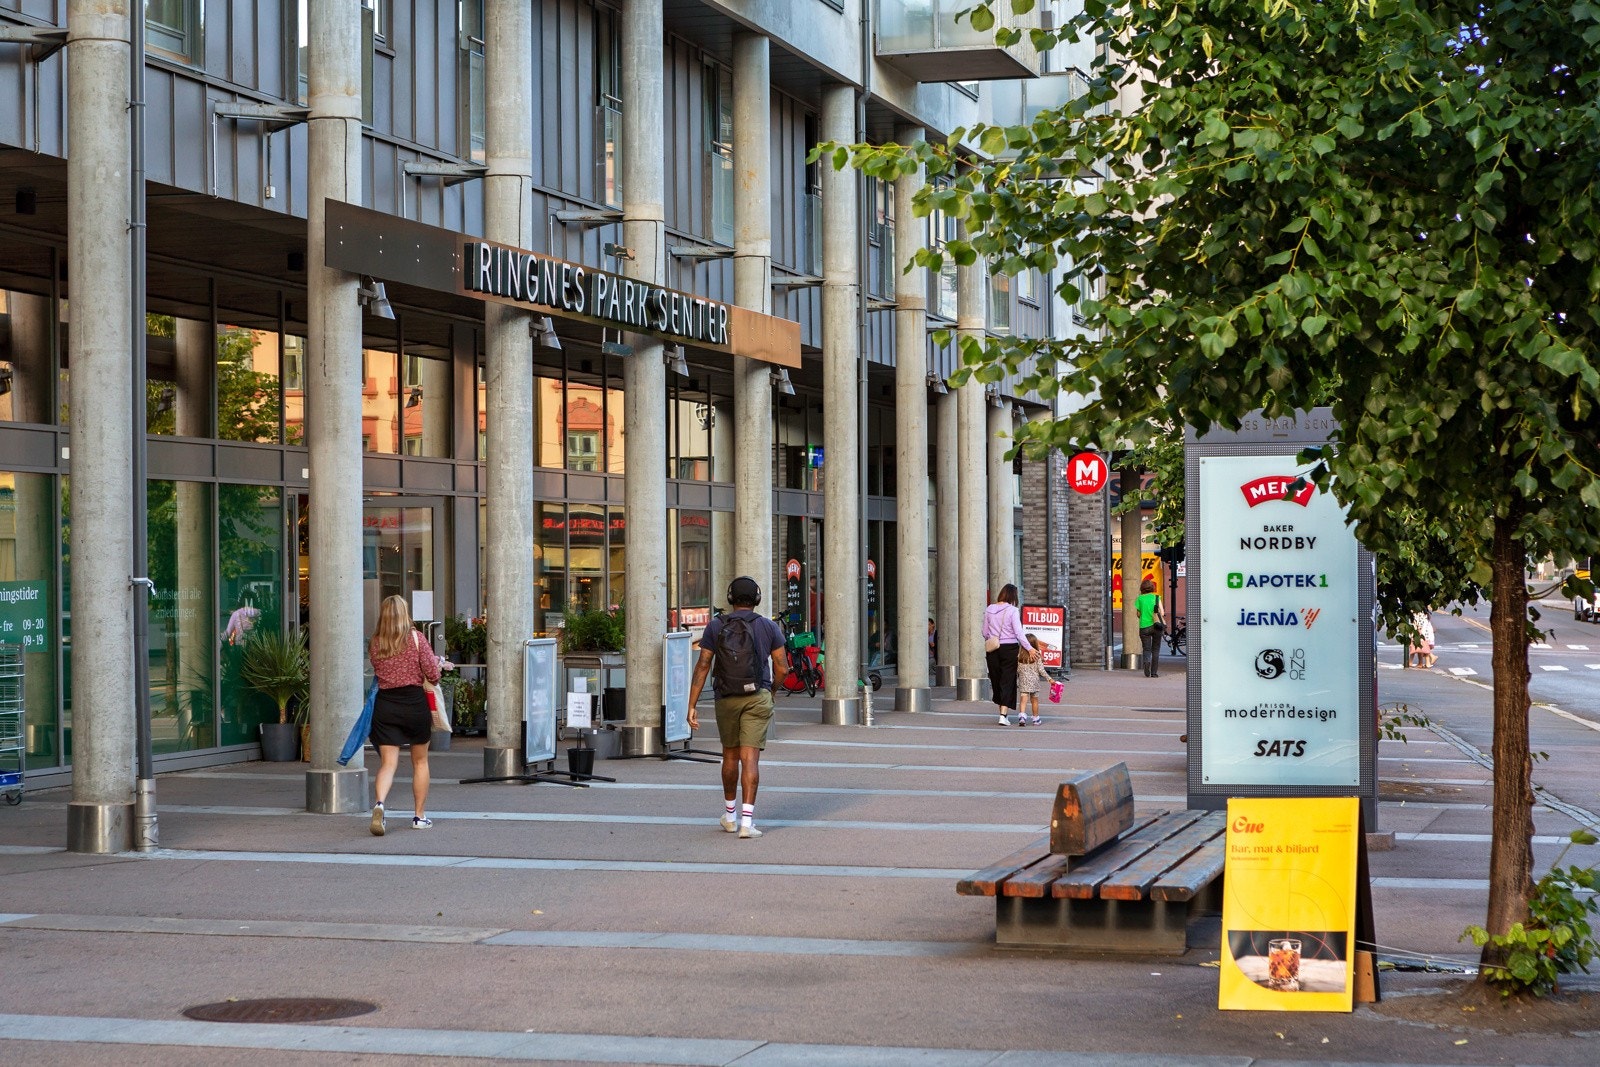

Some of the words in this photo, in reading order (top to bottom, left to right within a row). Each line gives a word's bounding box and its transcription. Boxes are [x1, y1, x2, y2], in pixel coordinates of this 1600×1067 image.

[475, 242, 585, 313] RINGNES
[596, 273, 650, 328] PARK
[658, 289, 729, 345] SENTER
[1303, 419, 1337, 430] SENT
[1075, 459, 1099, 482] M
[1240, 537, 1317, 550] NORDBY
[1246, 574, 1317, 588] APOTEK
[1026, 611, 1060, 624] TILBUD
[1225, 706, 1337, 722] moderndesign
[1254, 740, 1307, 757] SATS
[1232, 816, 1265, 833] Cue
[1231, 845, 1251, 854] Bar,
[1253, 845, 1273, 854] mat
[1275, 845, 1283, 854] &
[1285, 844, 1319, 855] biljard
